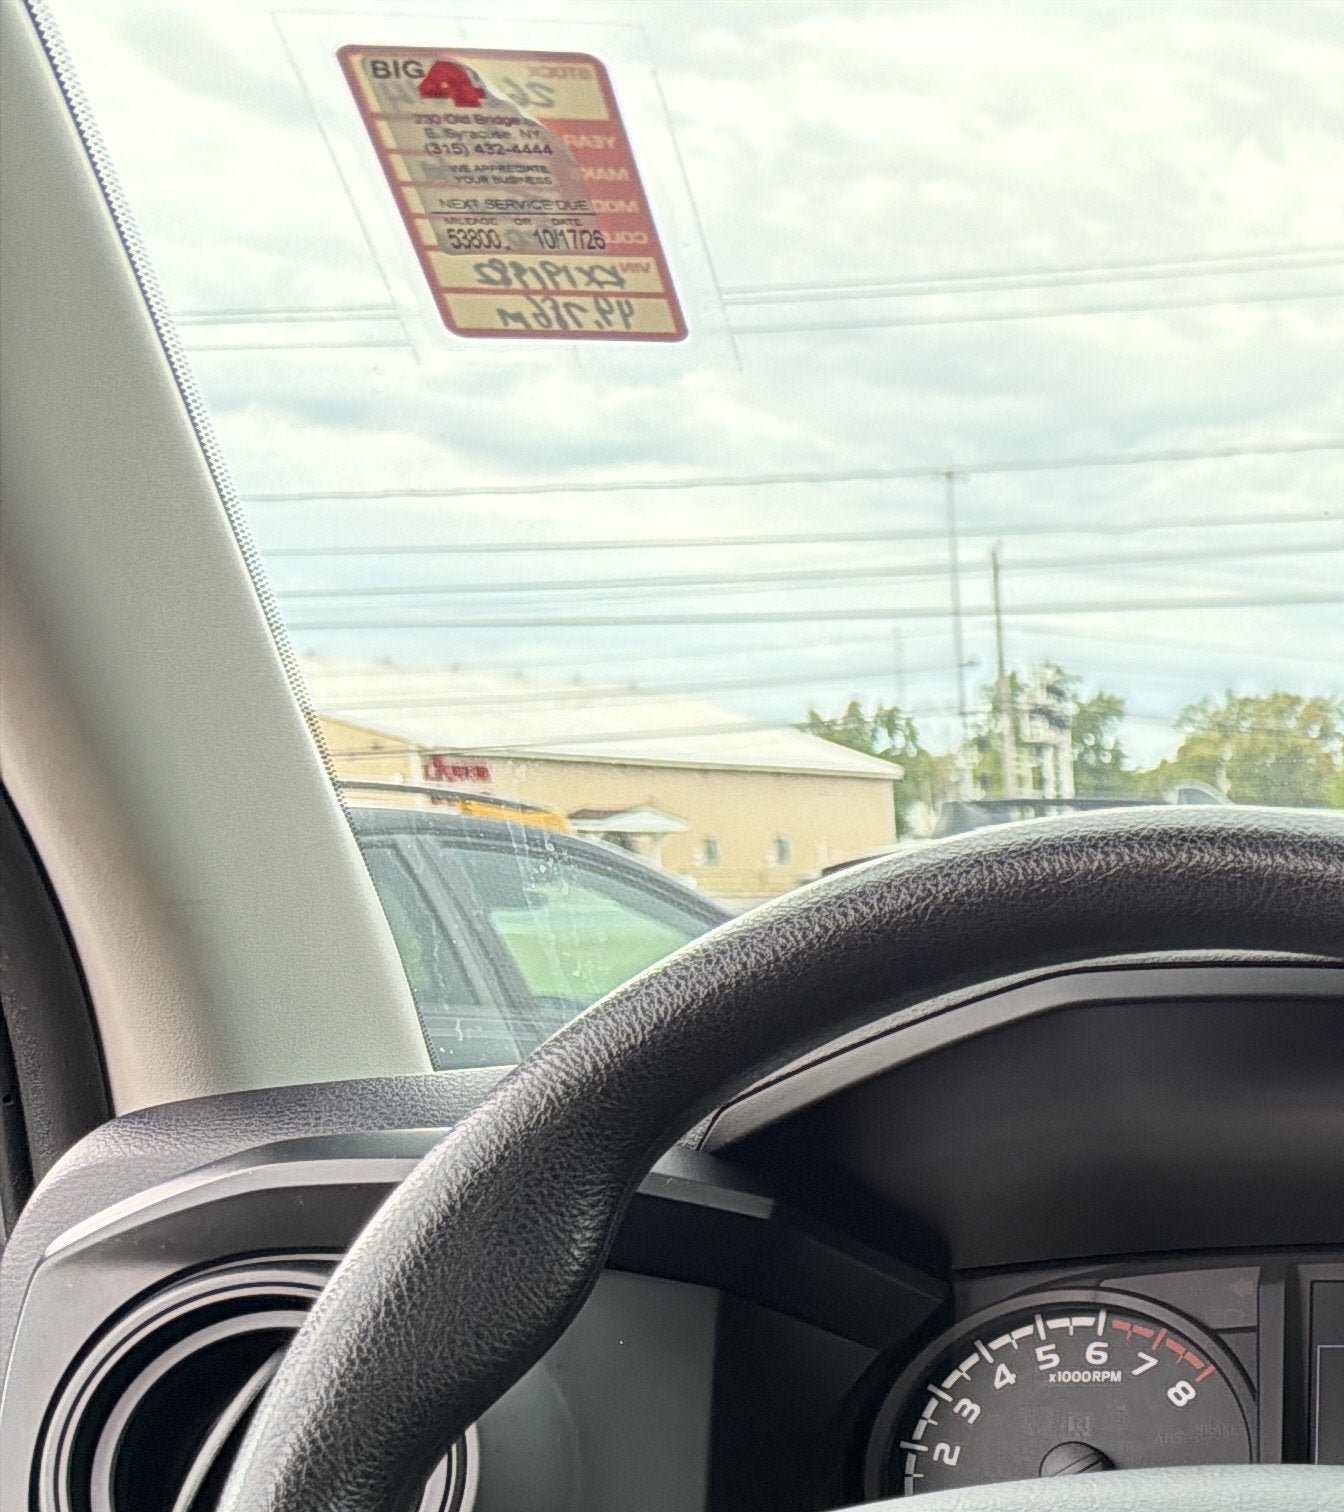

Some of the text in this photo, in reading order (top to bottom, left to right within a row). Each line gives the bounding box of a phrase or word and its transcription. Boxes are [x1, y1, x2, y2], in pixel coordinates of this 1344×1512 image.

[370, 59, 488, 109] BIG 4
[425, 142, 554, 157] (315) 432-4444
[438, 198, 591, 211] NEXT SERVICE DUE
[447, 229, 502, 250] 53800
[533, 229, 607, 250] 10/17/26
[1035, 1343, 1061, 1371] 5
[1085, 1342, 1109, 1365] 6
[1132, 1351, 1158, 1377] 7
[993, 1362, 1017, 1391] 4
[1166, 1380, 1197, 1408] 8
[953, 1396, 982, 1426] 3
[933, 1441, 961, 1467] 2
